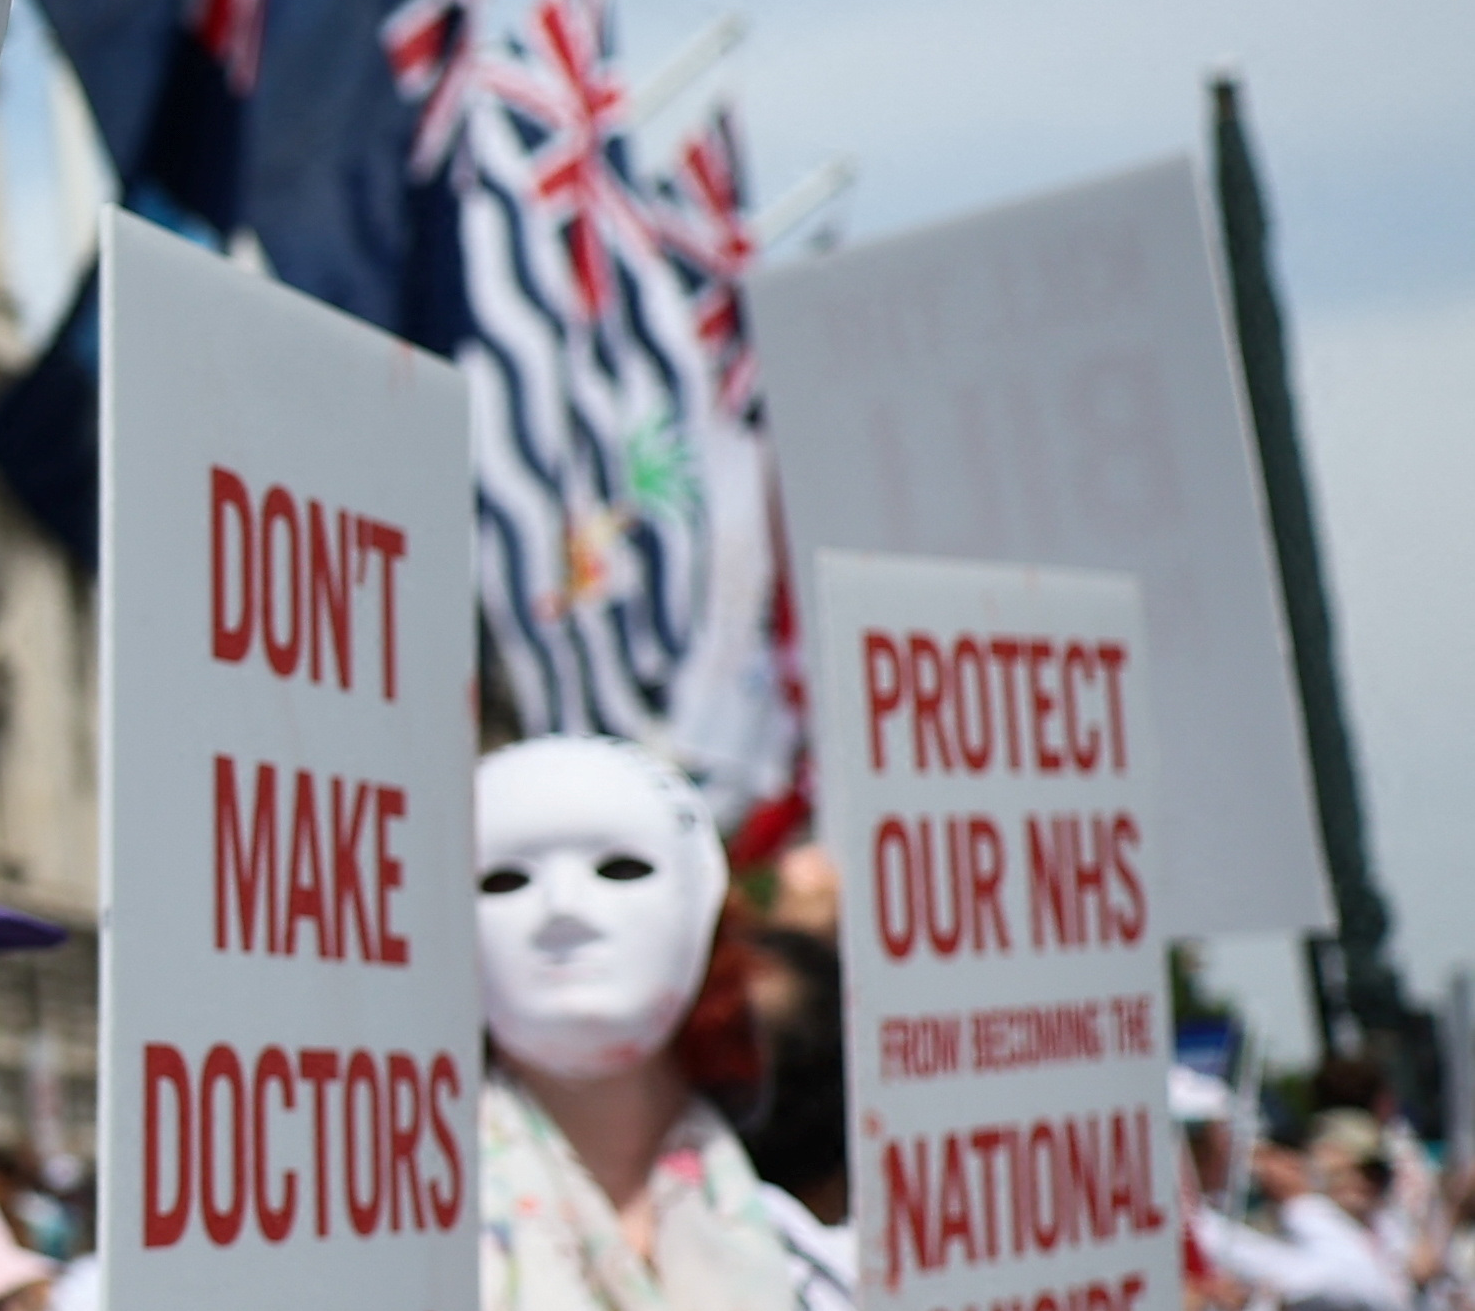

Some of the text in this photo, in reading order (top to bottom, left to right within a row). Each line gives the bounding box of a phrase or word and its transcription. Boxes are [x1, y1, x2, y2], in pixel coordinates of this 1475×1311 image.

[213, 469, 405, 697] DON'T
[865, 634, 1124, 771] PROTECT
[217, 757, 407, 964] MAKE
[873, 811, 1143, 961] OUR NHS
[879, 994, 1153, 1081] FROM BECOMING THE
[145, 1044, 461, 1247] DOCTORS
[883, 1107, 1165, 1281] NATIONAL
